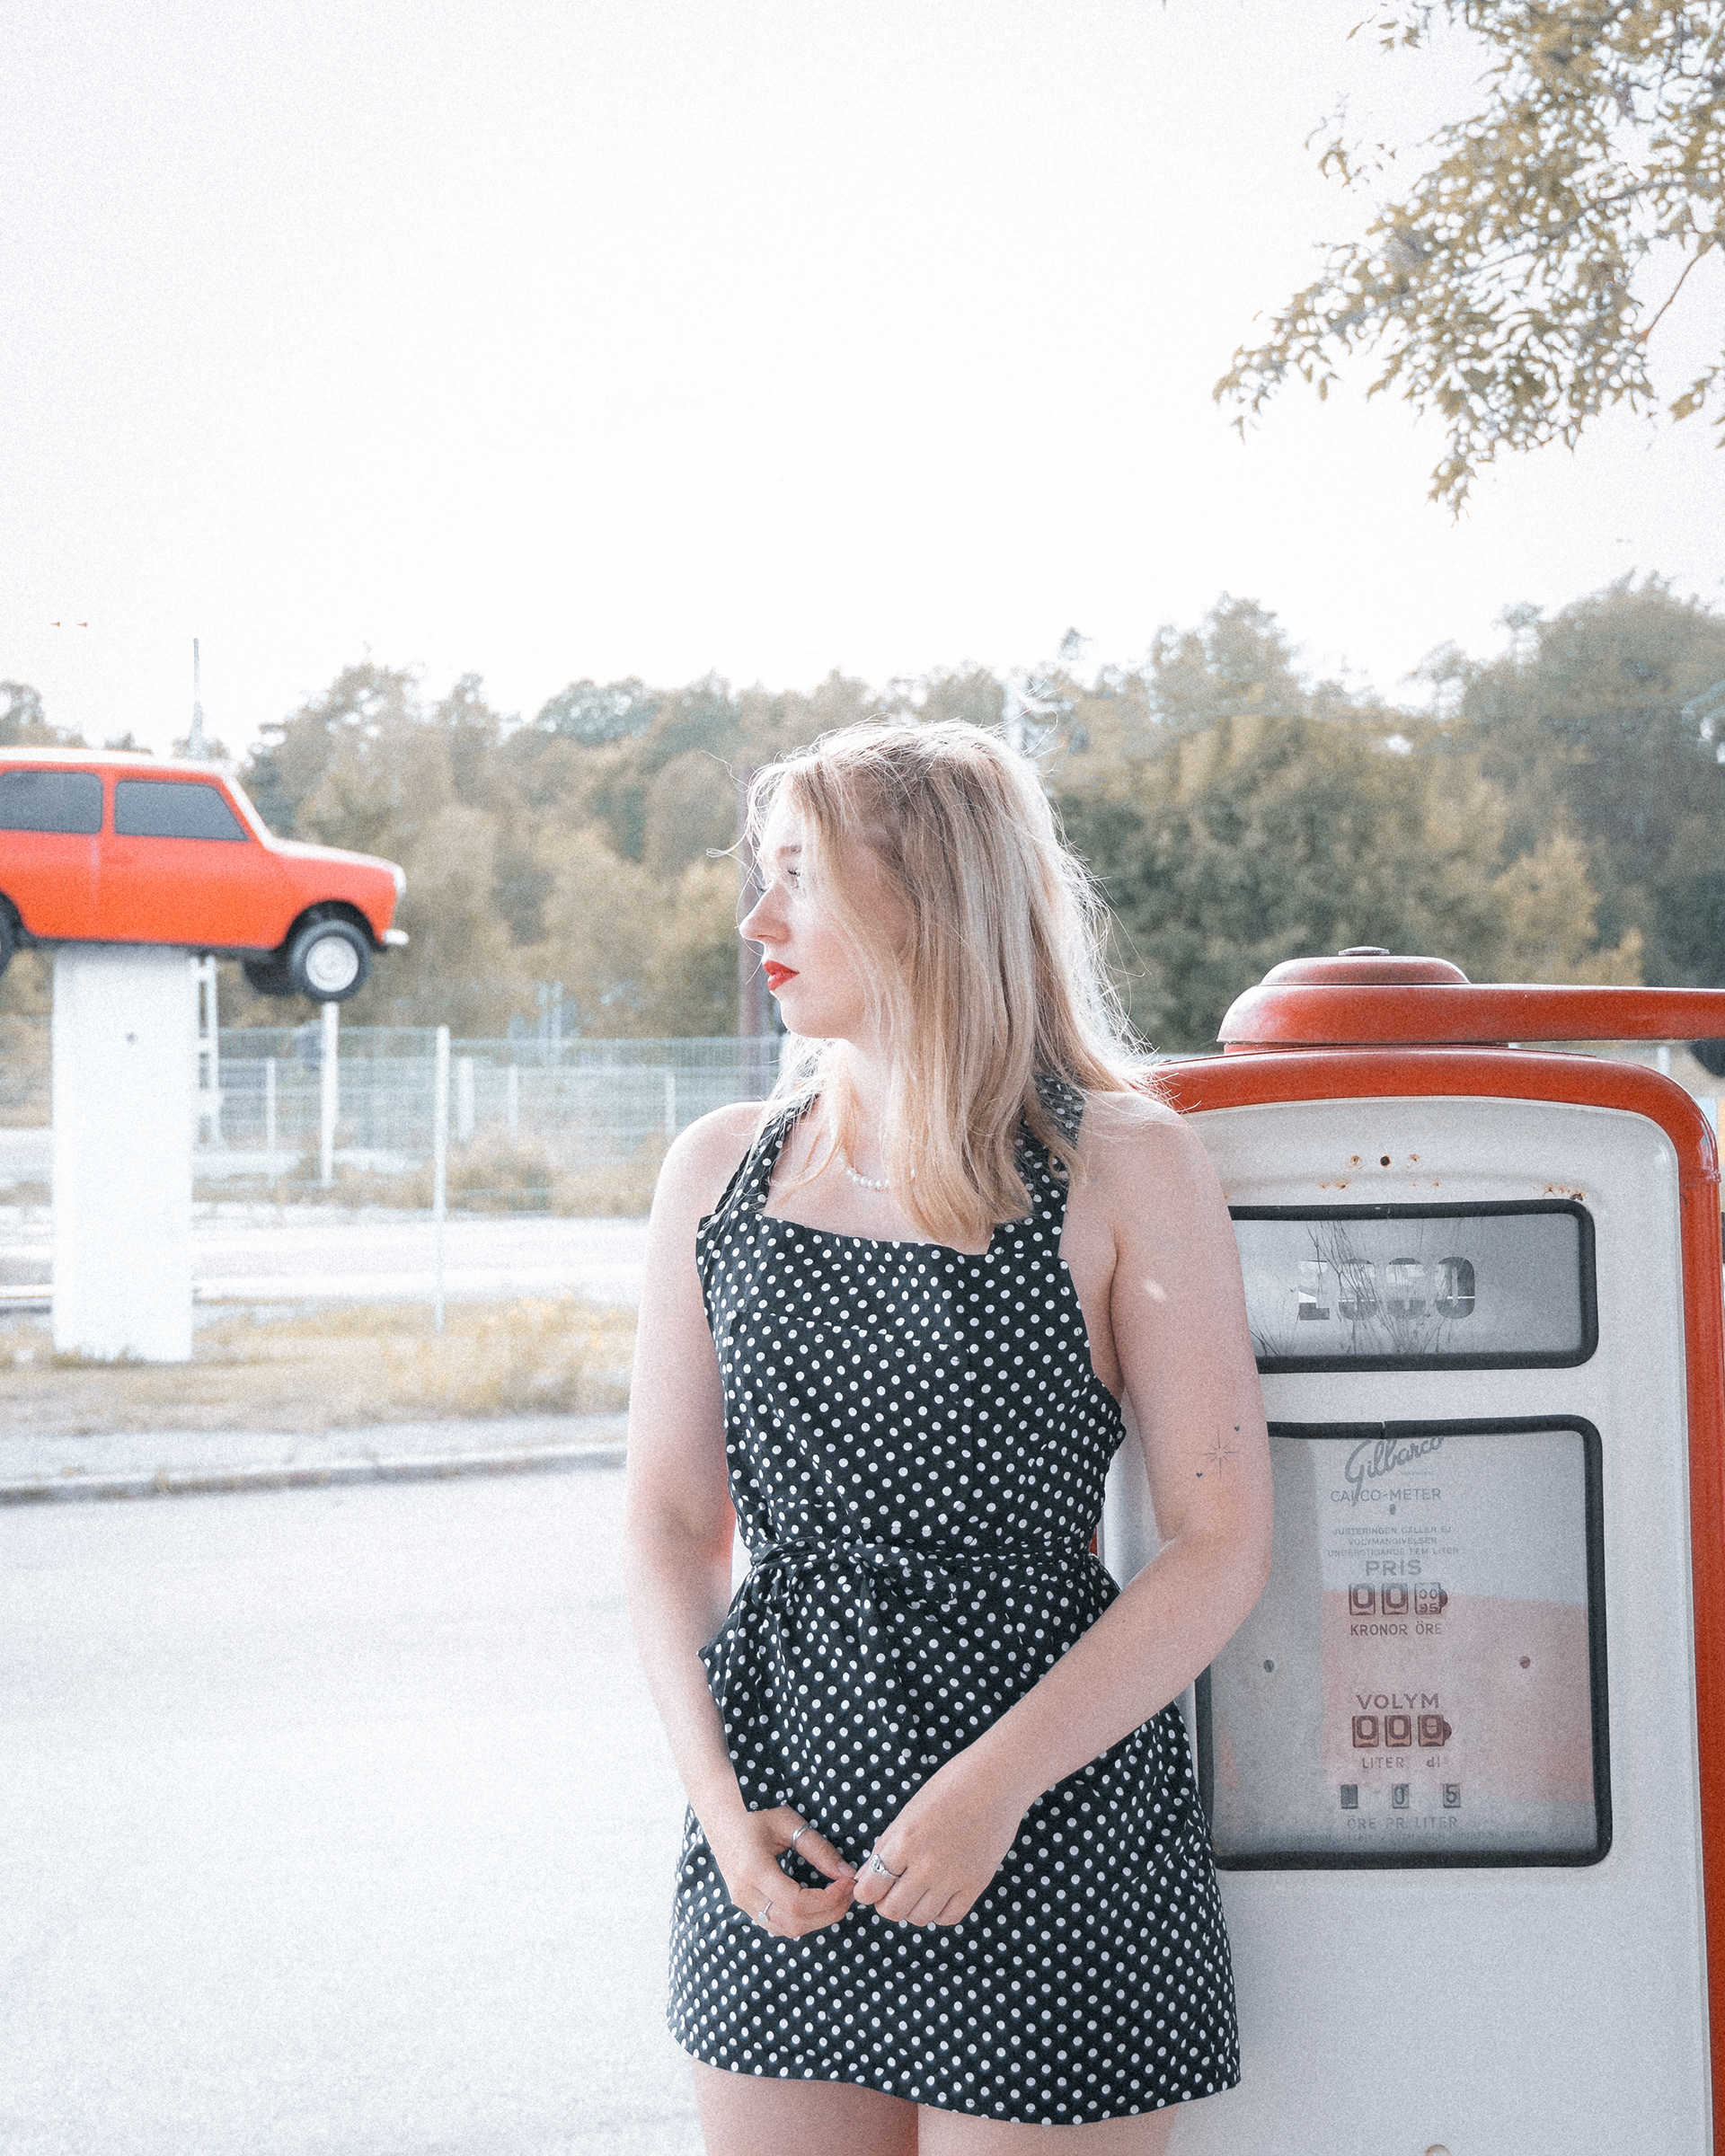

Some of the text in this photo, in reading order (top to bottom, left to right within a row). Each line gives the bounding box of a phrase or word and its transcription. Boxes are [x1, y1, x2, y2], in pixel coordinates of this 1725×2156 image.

[1345, 1437, 1444, 1507] Gilbarco
[1333, 1527, 1397, 1535] JUSTERINGEN
[1441, 1525, 1452, 1533] EJ
[1348, 1537, 1438, 1545] VOLYMANGIVELSER
[1328, 1546, 1459, 1557] UNDERSTIGANDE FEM LITER
[1366, 1560, 1422, 1577] PRIS
[1350, 1621, 1442, 1636] KRONOR ÖRE
[1356, 1693, 1439, 1710] VOLYM
[1362, 1757, 1404, 1769] LITER
[1445, 1783, 1457, 1804] 5
[1348, 1815, 1376, 1830] ÖRE
[1415, 1816, 1458, 1829] LITER
